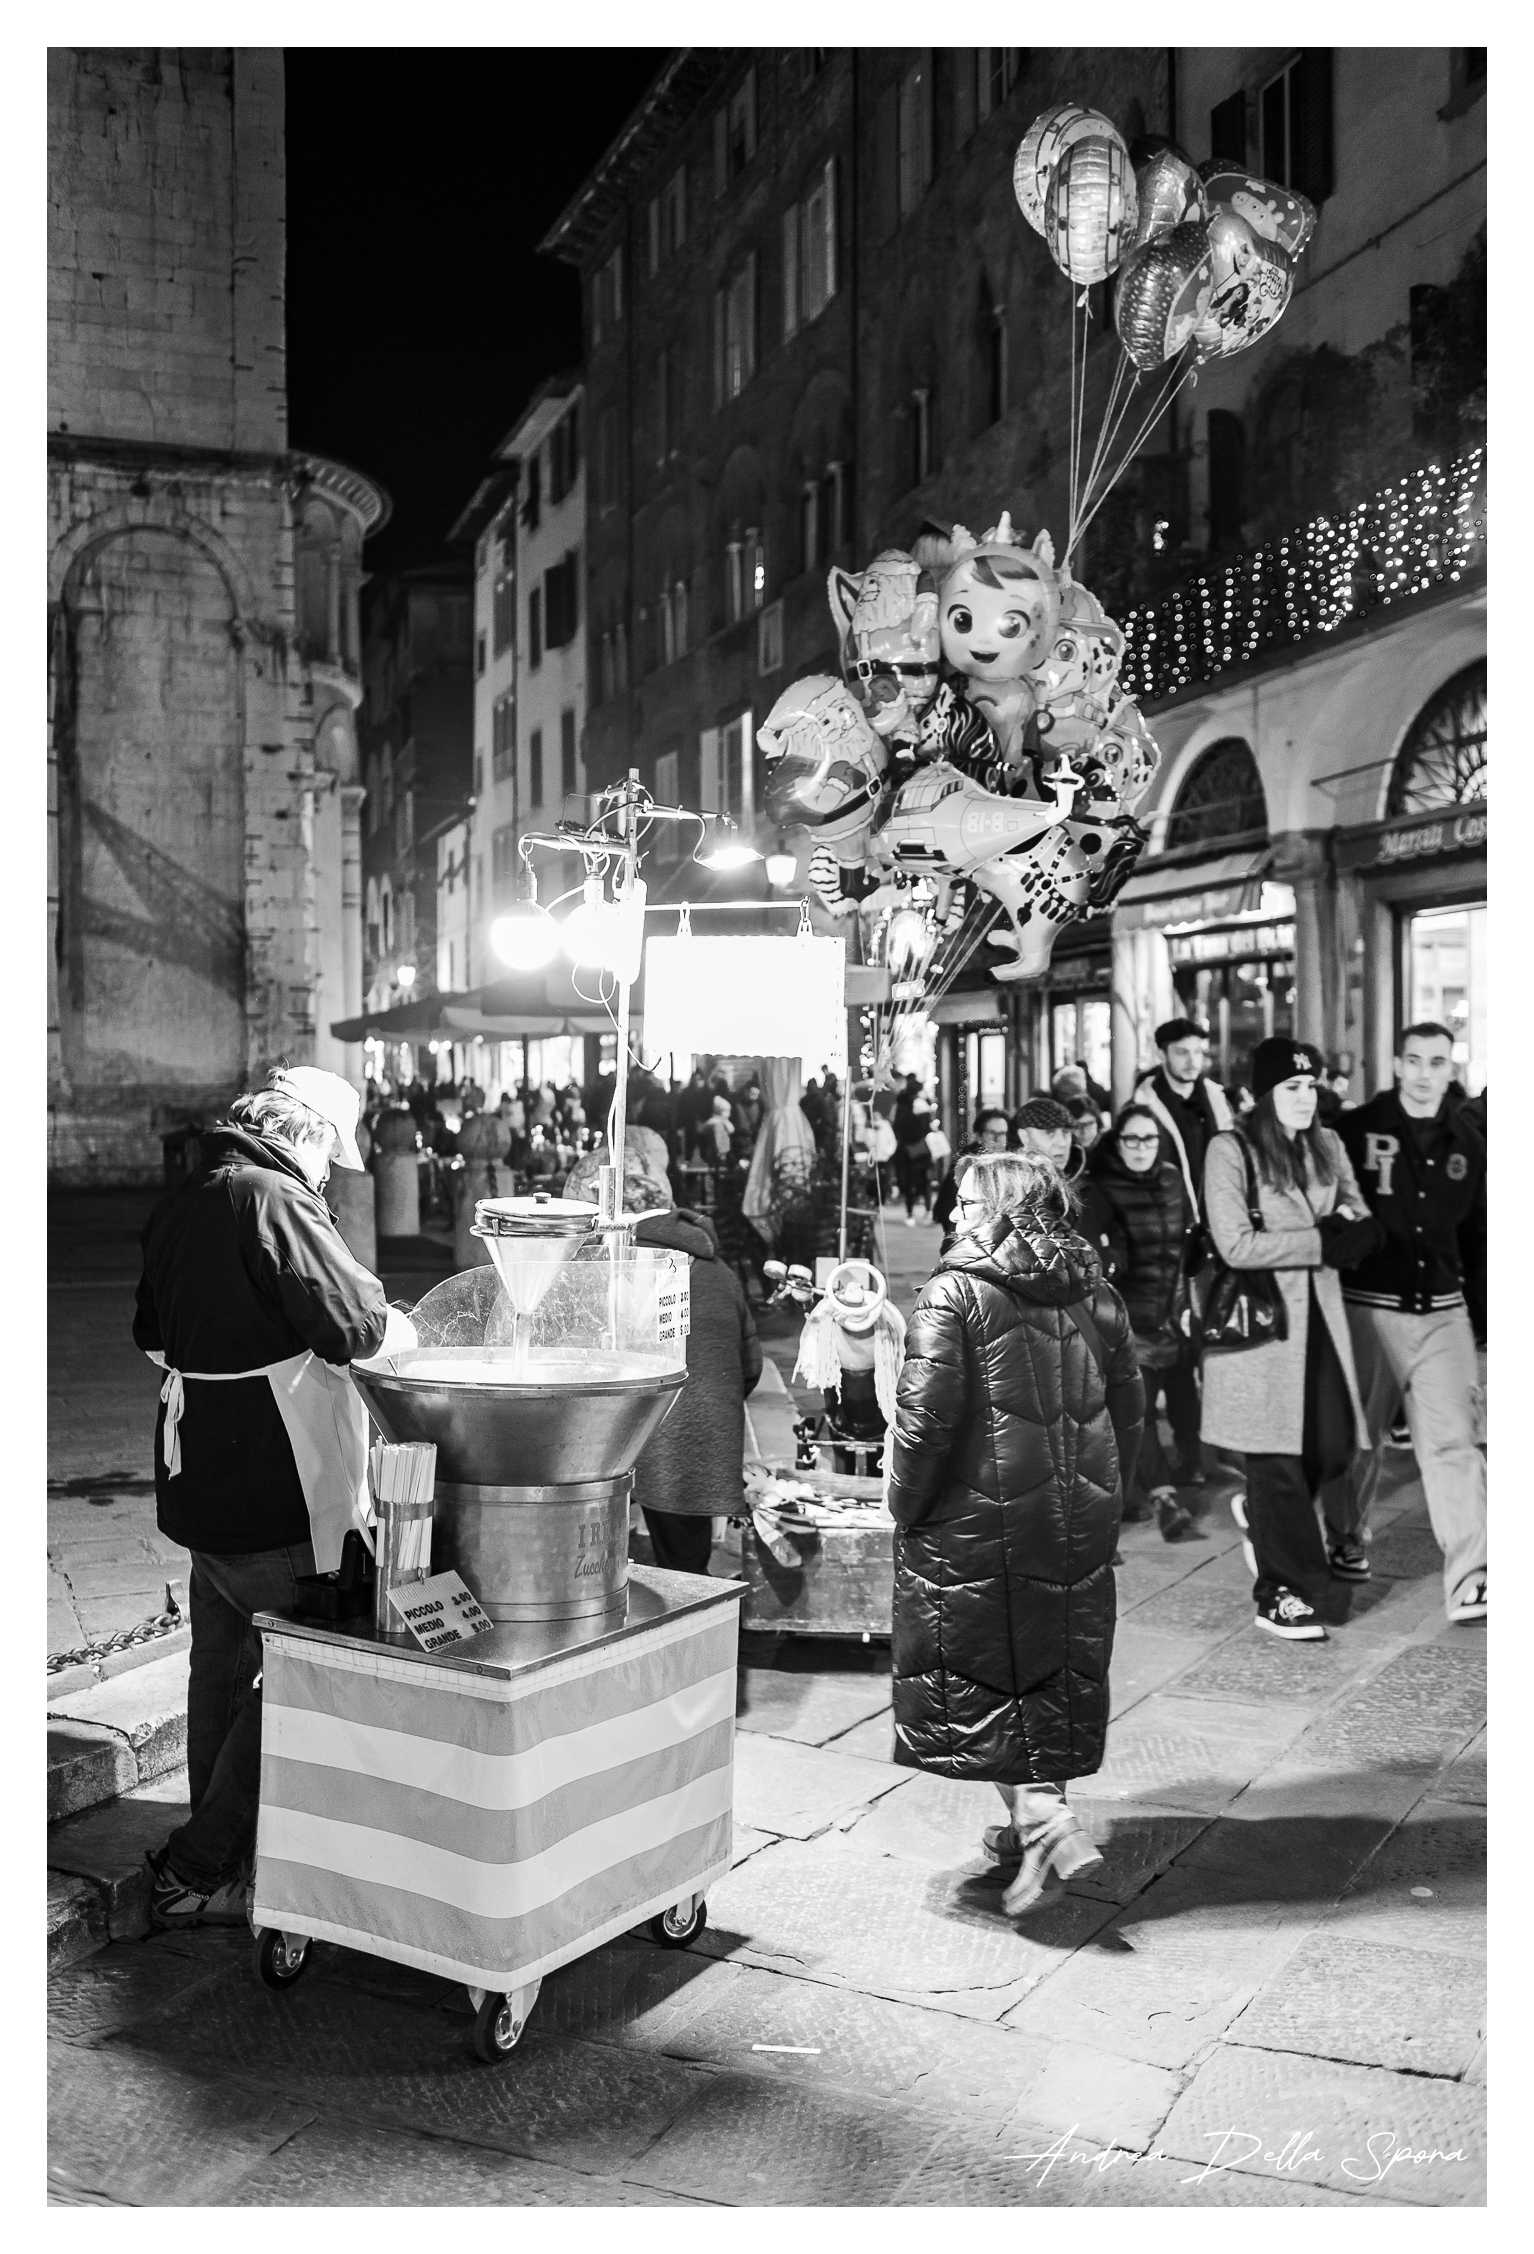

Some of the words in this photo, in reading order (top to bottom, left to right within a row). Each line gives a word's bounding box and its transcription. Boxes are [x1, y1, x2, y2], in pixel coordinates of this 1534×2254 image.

[659, 1294, 676, 1307] PICCOLO
[659, 1312, 672, 1324] MEDIO
[659, 1327, 675, 1341] GRANDE
[403, 1600, 445, 1621] PICCOLO
[413, 1617, 445, 1636] MEDIO
[462, 1605, 482, 1620] 4.00
[424, 1629, 463, 1650] GRANDE
[471, 1619, 492, 1634] 5.00
